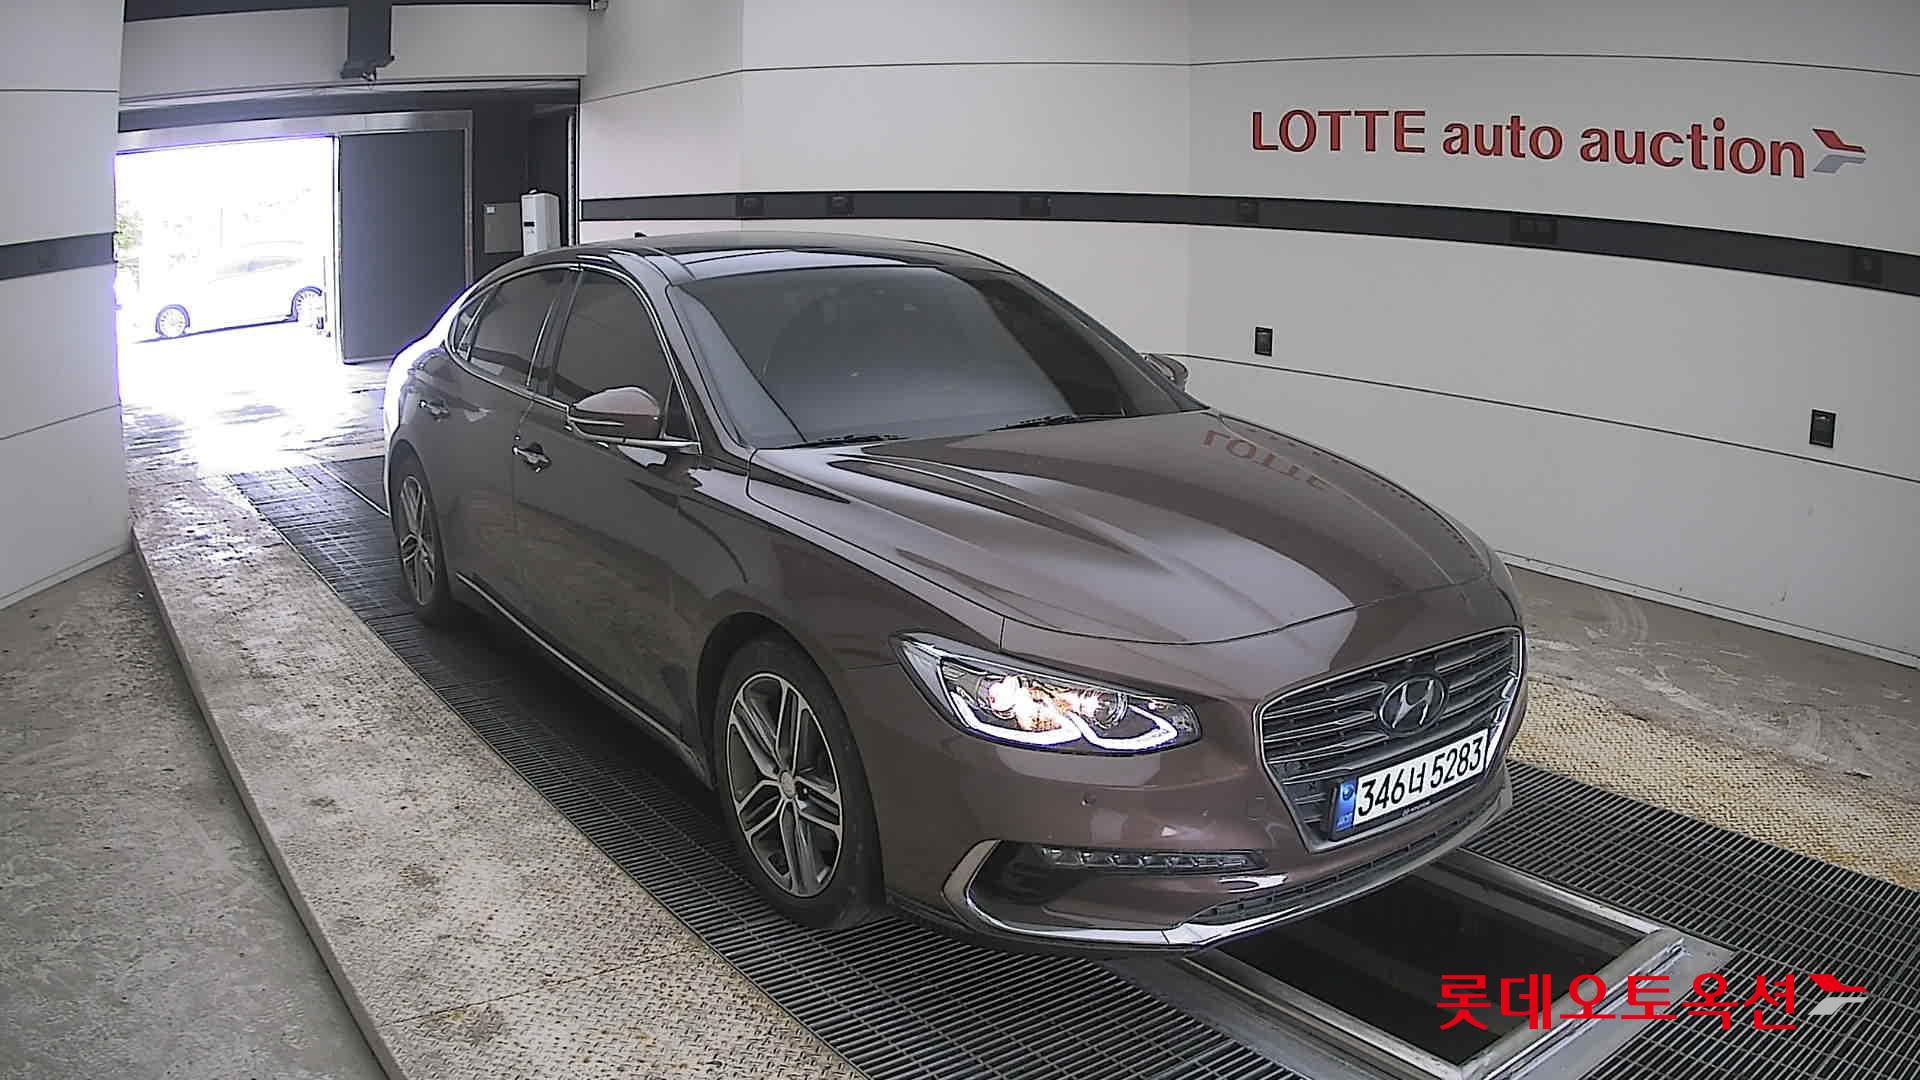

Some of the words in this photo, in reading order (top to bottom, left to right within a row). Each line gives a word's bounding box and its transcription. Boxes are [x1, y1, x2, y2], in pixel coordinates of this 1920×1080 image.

[1252, 110, 1426, 154] LOTTE
[1441, 115, 1563, 161] auto
[1579, 117, 1806, 179] auction
[1358, 762, 1426, 817] 346너
[1430, 736, 1484, 788] 5283
